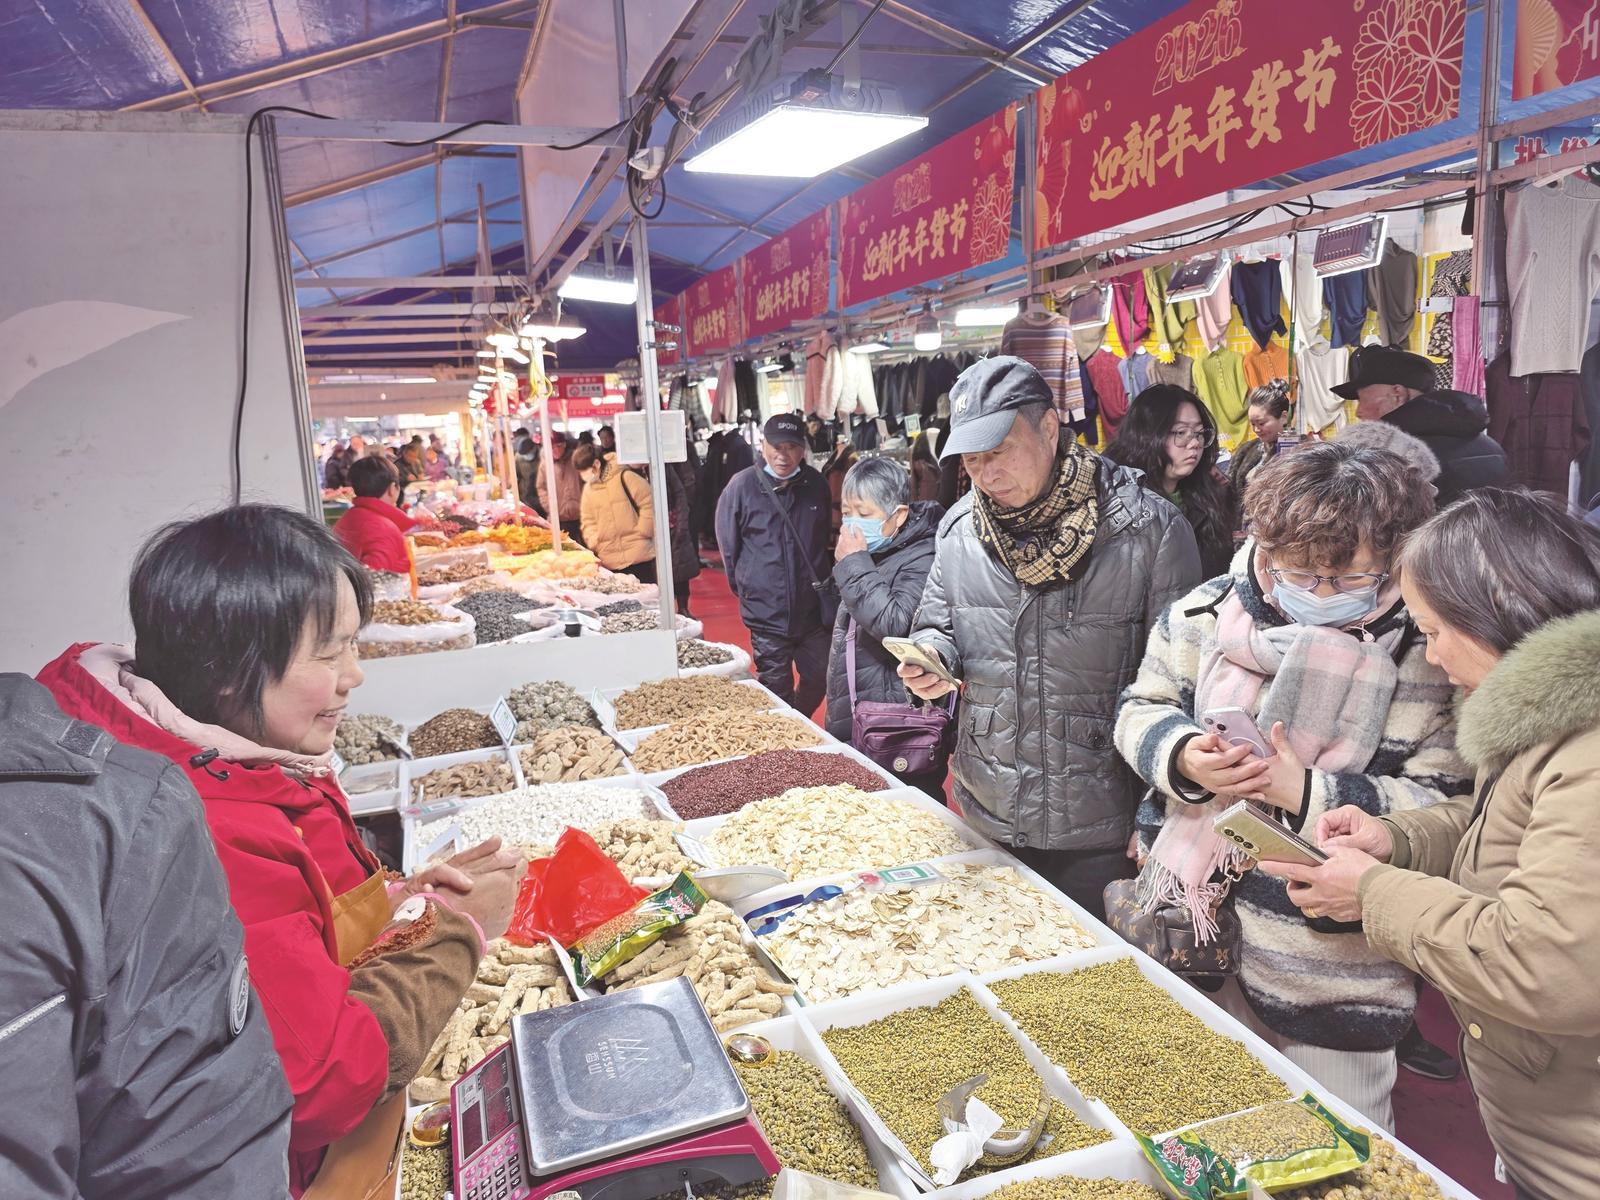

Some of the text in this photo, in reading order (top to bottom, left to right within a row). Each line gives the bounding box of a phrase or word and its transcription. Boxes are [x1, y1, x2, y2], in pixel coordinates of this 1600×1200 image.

[1152, 0, 1247, 96] 2026
[1089, 35, 1342, 201] 迎新年年货节
[862, 198, 968, 281] 迎新年年货节
[756, 266, 810, 322] 迎新年年货节
